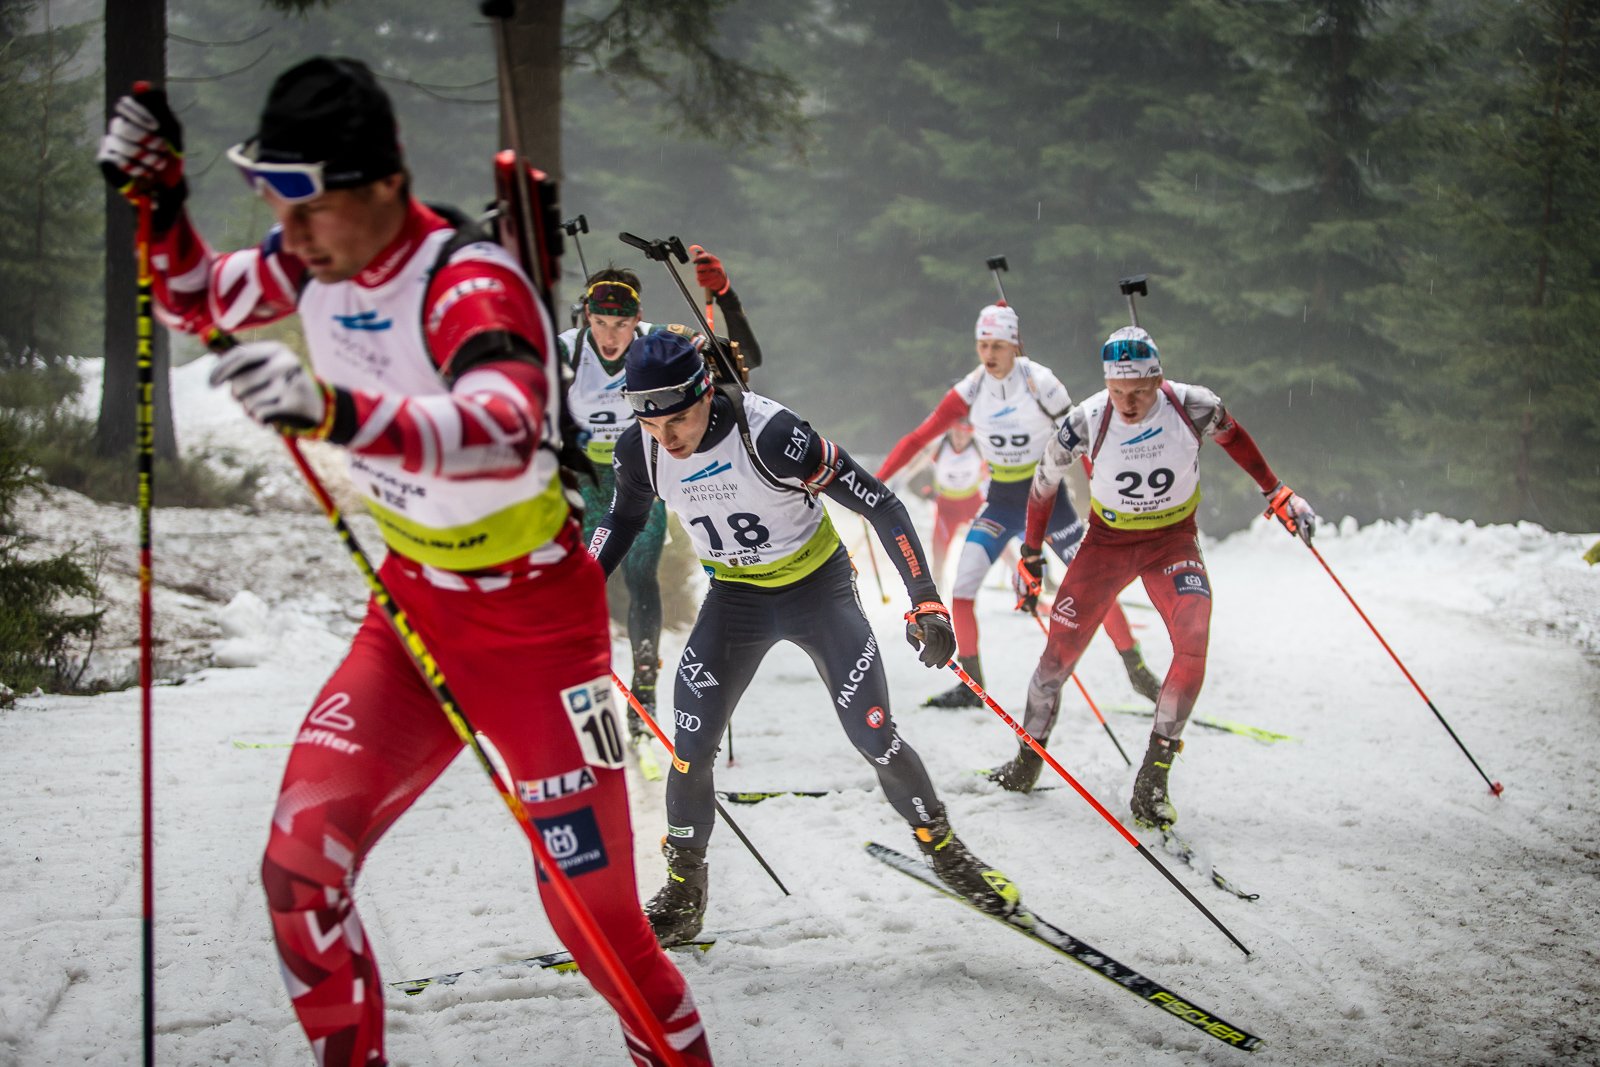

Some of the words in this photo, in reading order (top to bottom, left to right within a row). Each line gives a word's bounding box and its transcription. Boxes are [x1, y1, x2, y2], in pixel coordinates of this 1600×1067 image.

[784, 426, 808, 462] EA7
[1124, 451, 1162, 461] AIRPORT
[689, 492, 737, 502] AIRPORT
[1115, 467, 1175, 499] 29
[689, 512, 770, 551] 18
[895, 533, 922, 578] FINSTRAL
[680, 646, 720, 688] EA7
[582, 709, 623, 764] 10
[1150, 991, 1246, 1046] FISCHER
